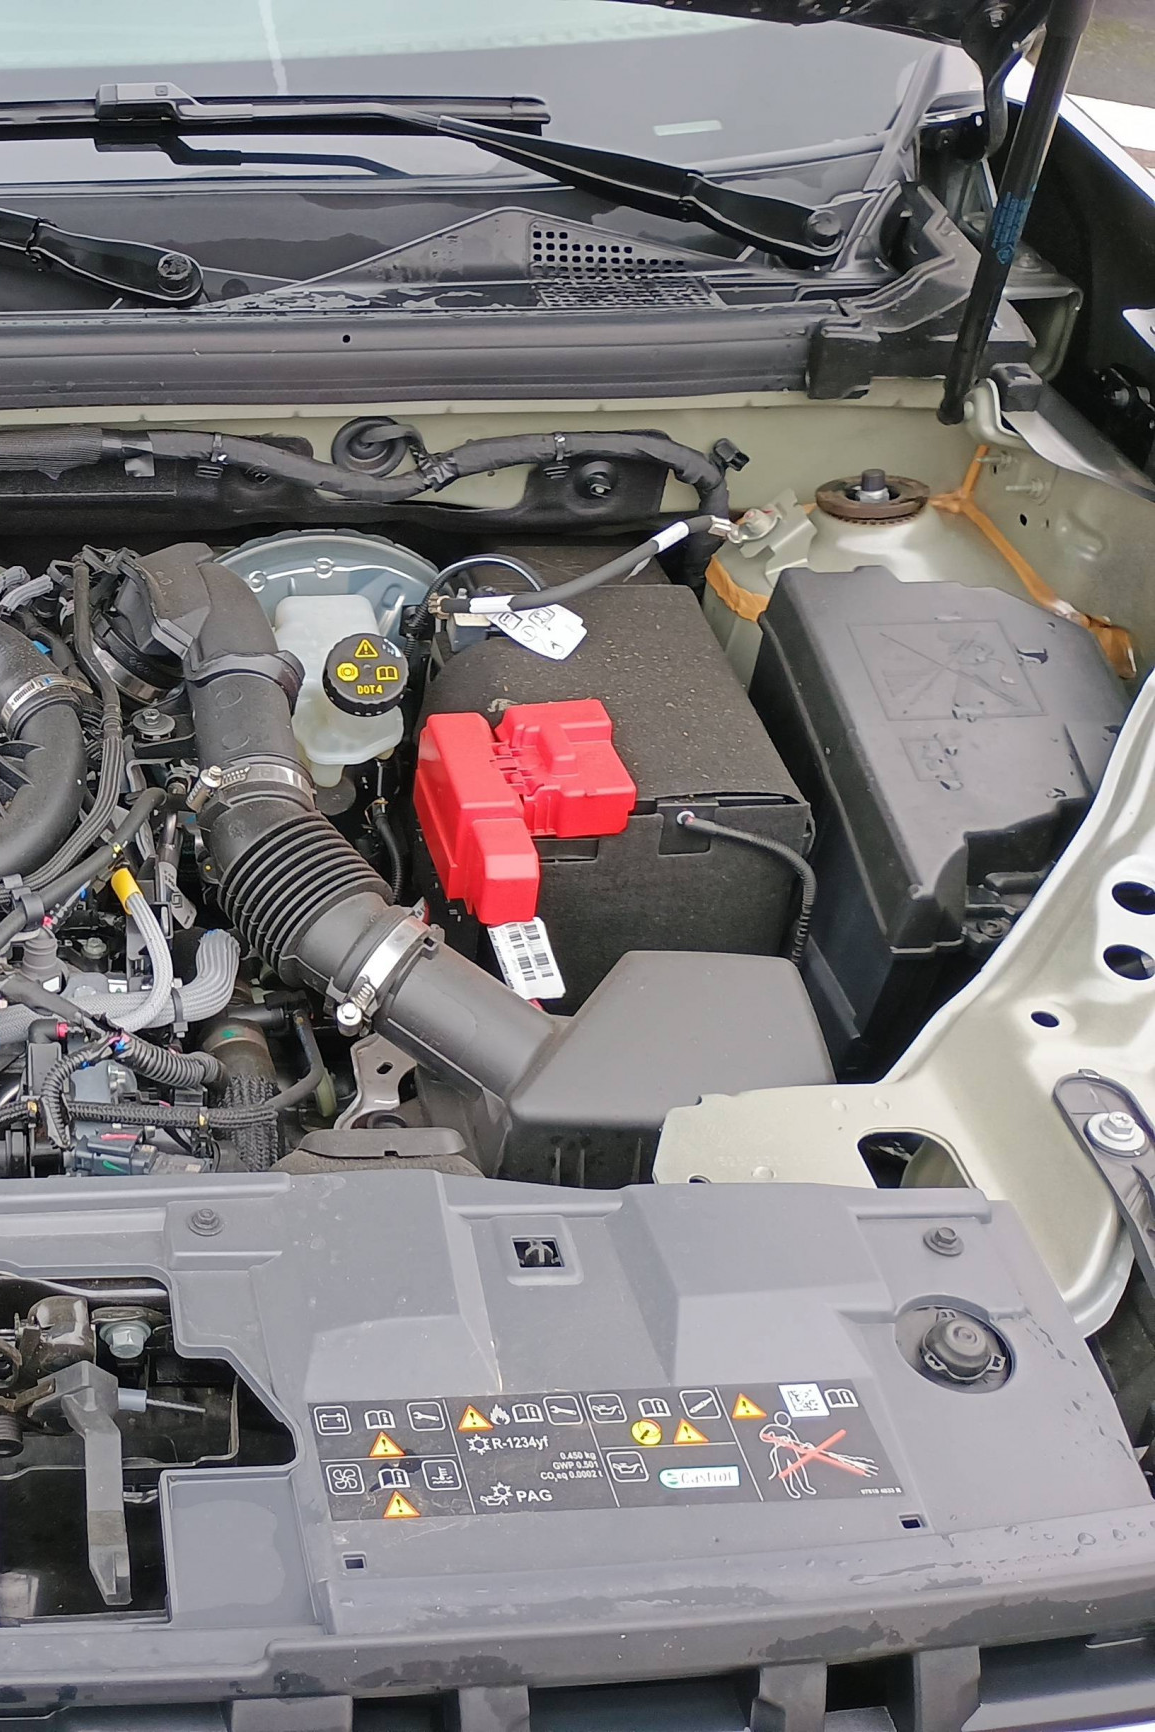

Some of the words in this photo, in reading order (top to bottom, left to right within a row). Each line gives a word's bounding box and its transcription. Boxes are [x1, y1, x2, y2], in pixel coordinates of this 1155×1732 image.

[356, 684, 383, 695] DOT4
[491, 1435, 549, 1451] R-1234yf
[559, 1451, 584, 1460] 0.450
[584, 1450, 597, 1461] kg
[552, 1461, 575, 1470] GWP
[576, 1460, 599, 1469] 0.501
[568, 1469, 597, 1479] 0.0002
[681, 1471, 733, 1484] Castrol
[515, 1489, 553, 1503] PAG
